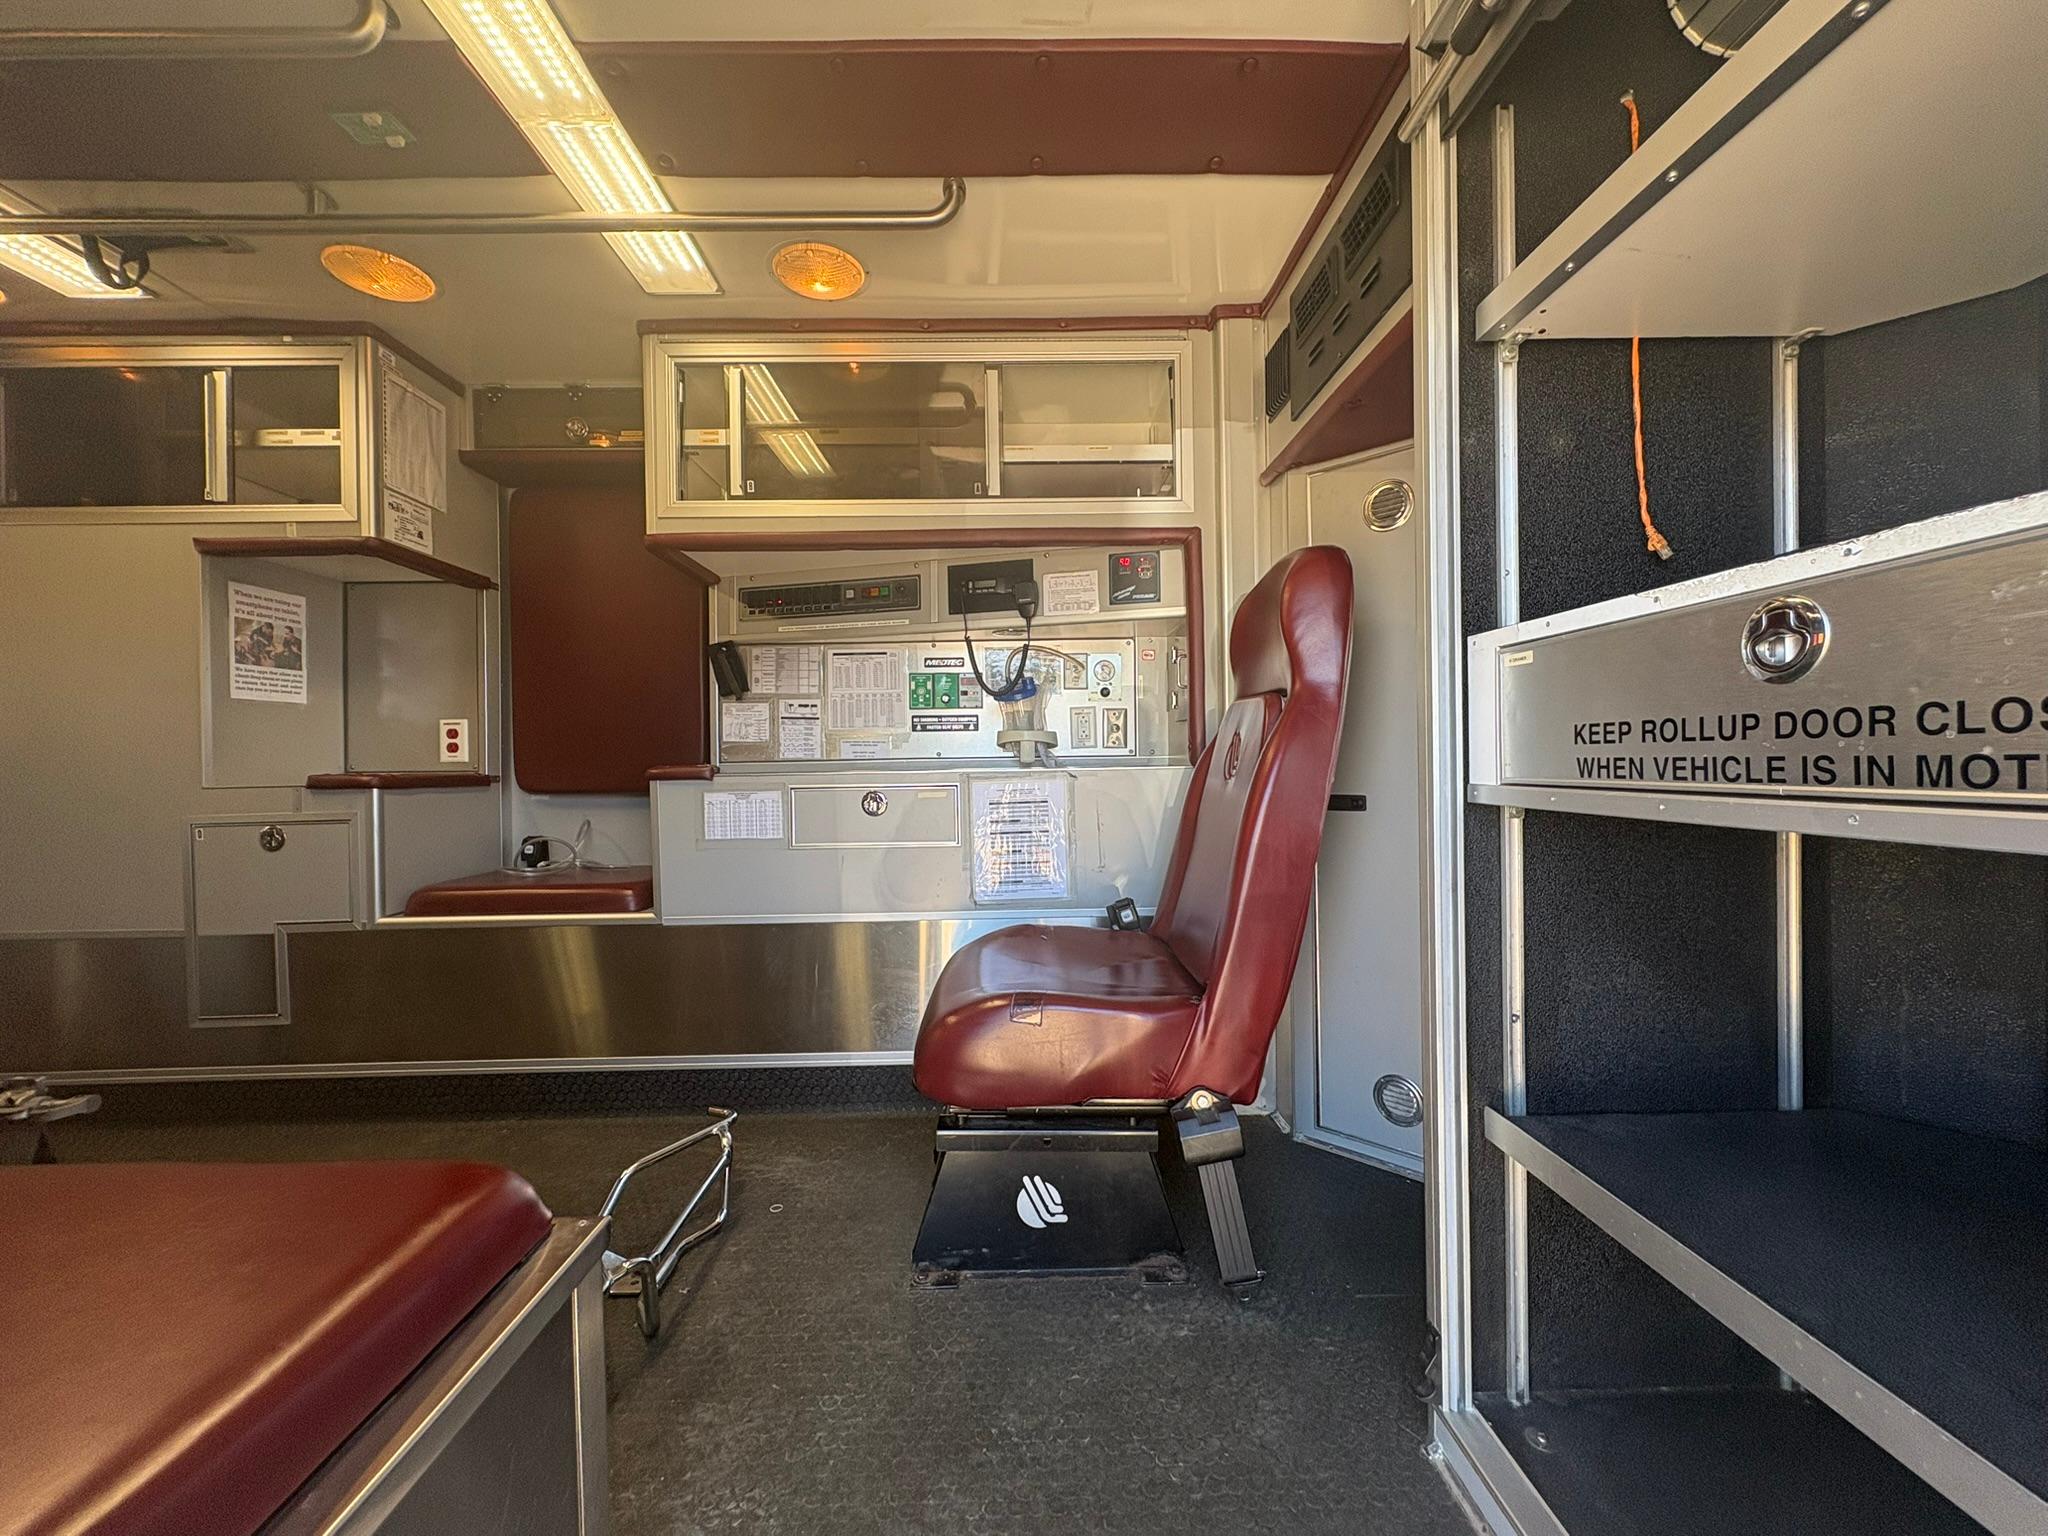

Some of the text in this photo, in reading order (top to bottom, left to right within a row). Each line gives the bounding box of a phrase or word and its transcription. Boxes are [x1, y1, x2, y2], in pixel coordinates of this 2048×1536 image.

[1574, 696, 2048, 745] KEEP ROLLUP DOOR CLO
[1576, 754, 2048, 789] WHEN VEHICLE IS IN MOT
